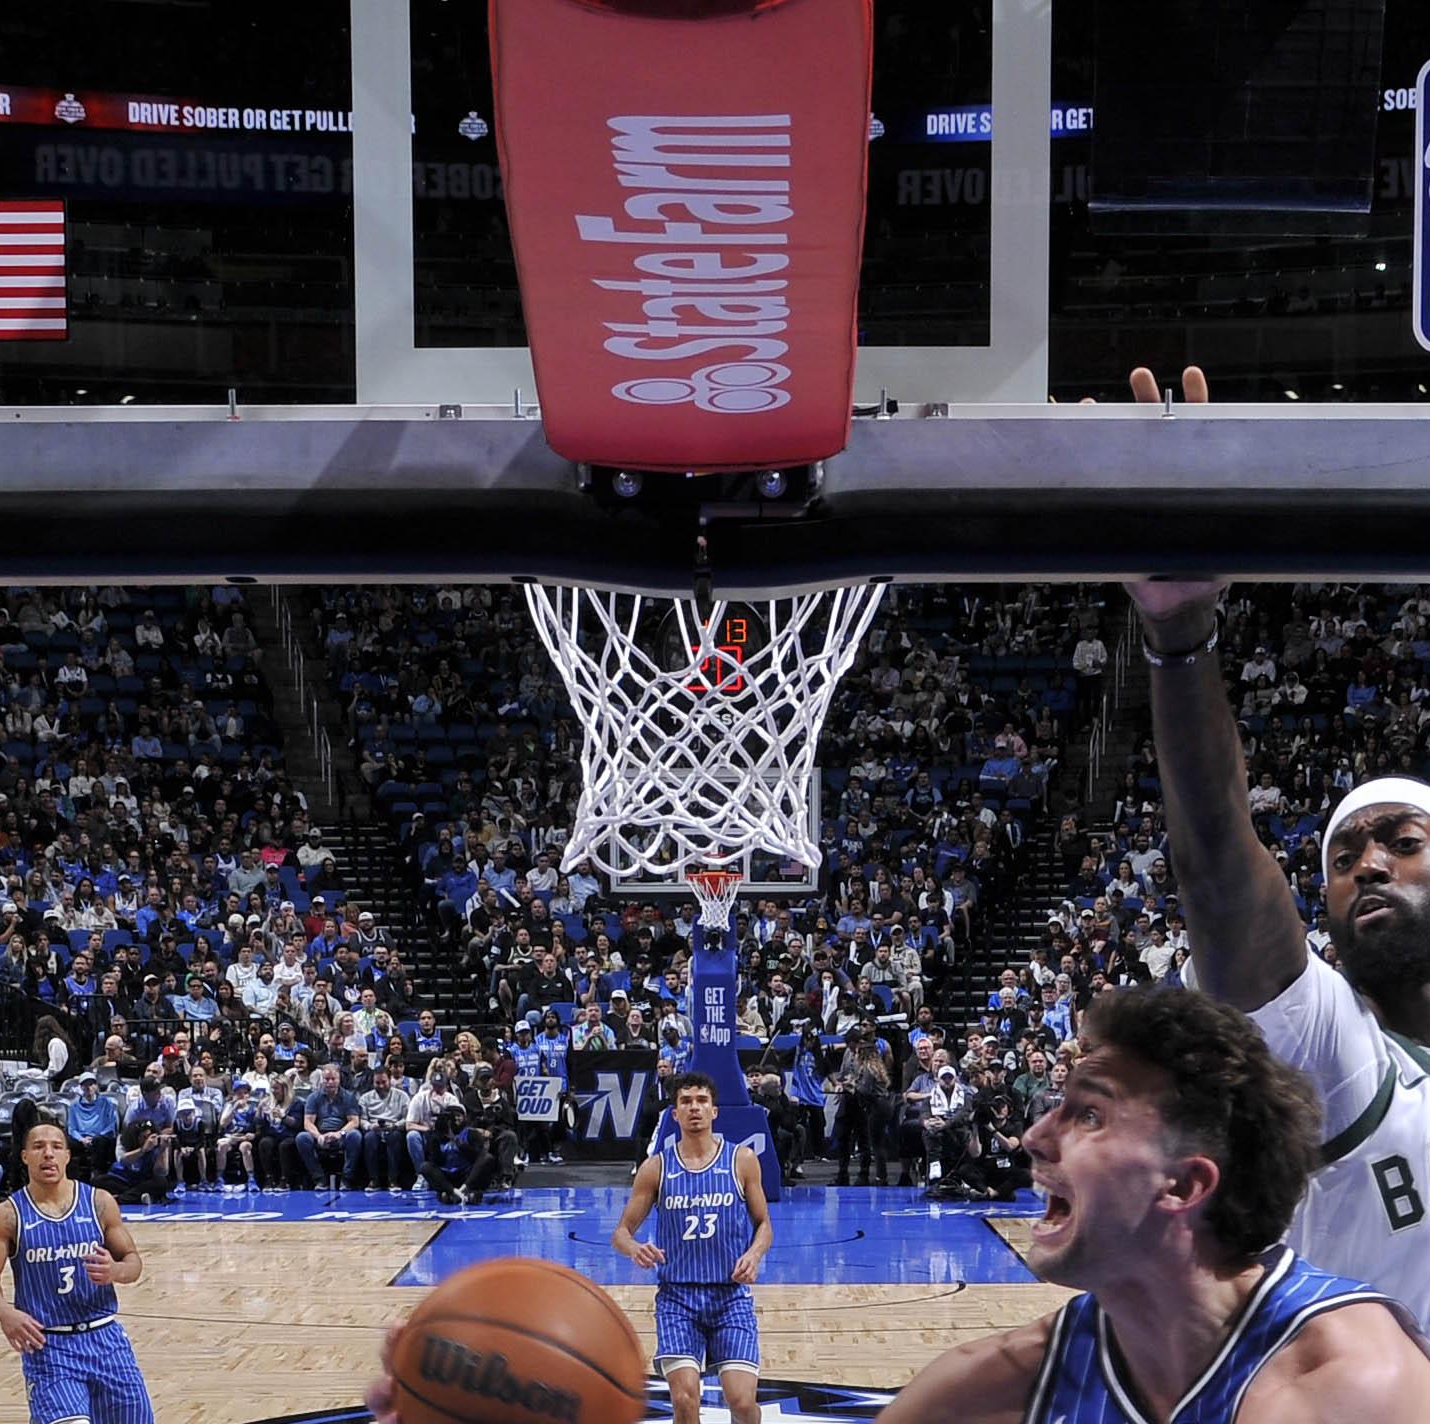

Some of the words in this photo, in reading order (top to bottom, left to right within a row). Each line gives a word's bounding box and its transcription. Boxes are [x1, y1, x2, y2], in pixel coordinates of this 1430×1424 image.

[1384, 89, 1417, 112] SOB
[128, 101, 180, 127] DRIVE
[183, 104, 240, 129] SOBER
[243, 108, 268, 130] OR
[270, 109, 303, 131] GET
[305, 110, 352, 132] PULL
[927, 113, 977, 136] DRIVE
[1065, 108, 1093, 131] GET
[574, 114, 794, 245] Farm
[591, 252, 790, 360] State
[704, 986, 725, 1005] GET
[704, 1006, 726, 1024] THE
[709, 1028, 731, 1047] App
[518, 1079, 550, 1095] GET
[682, 1213, 719, 1241] 23
[57, 1265, 76, 1295] 3
[420, 1333, 582, 1424] Wilson
